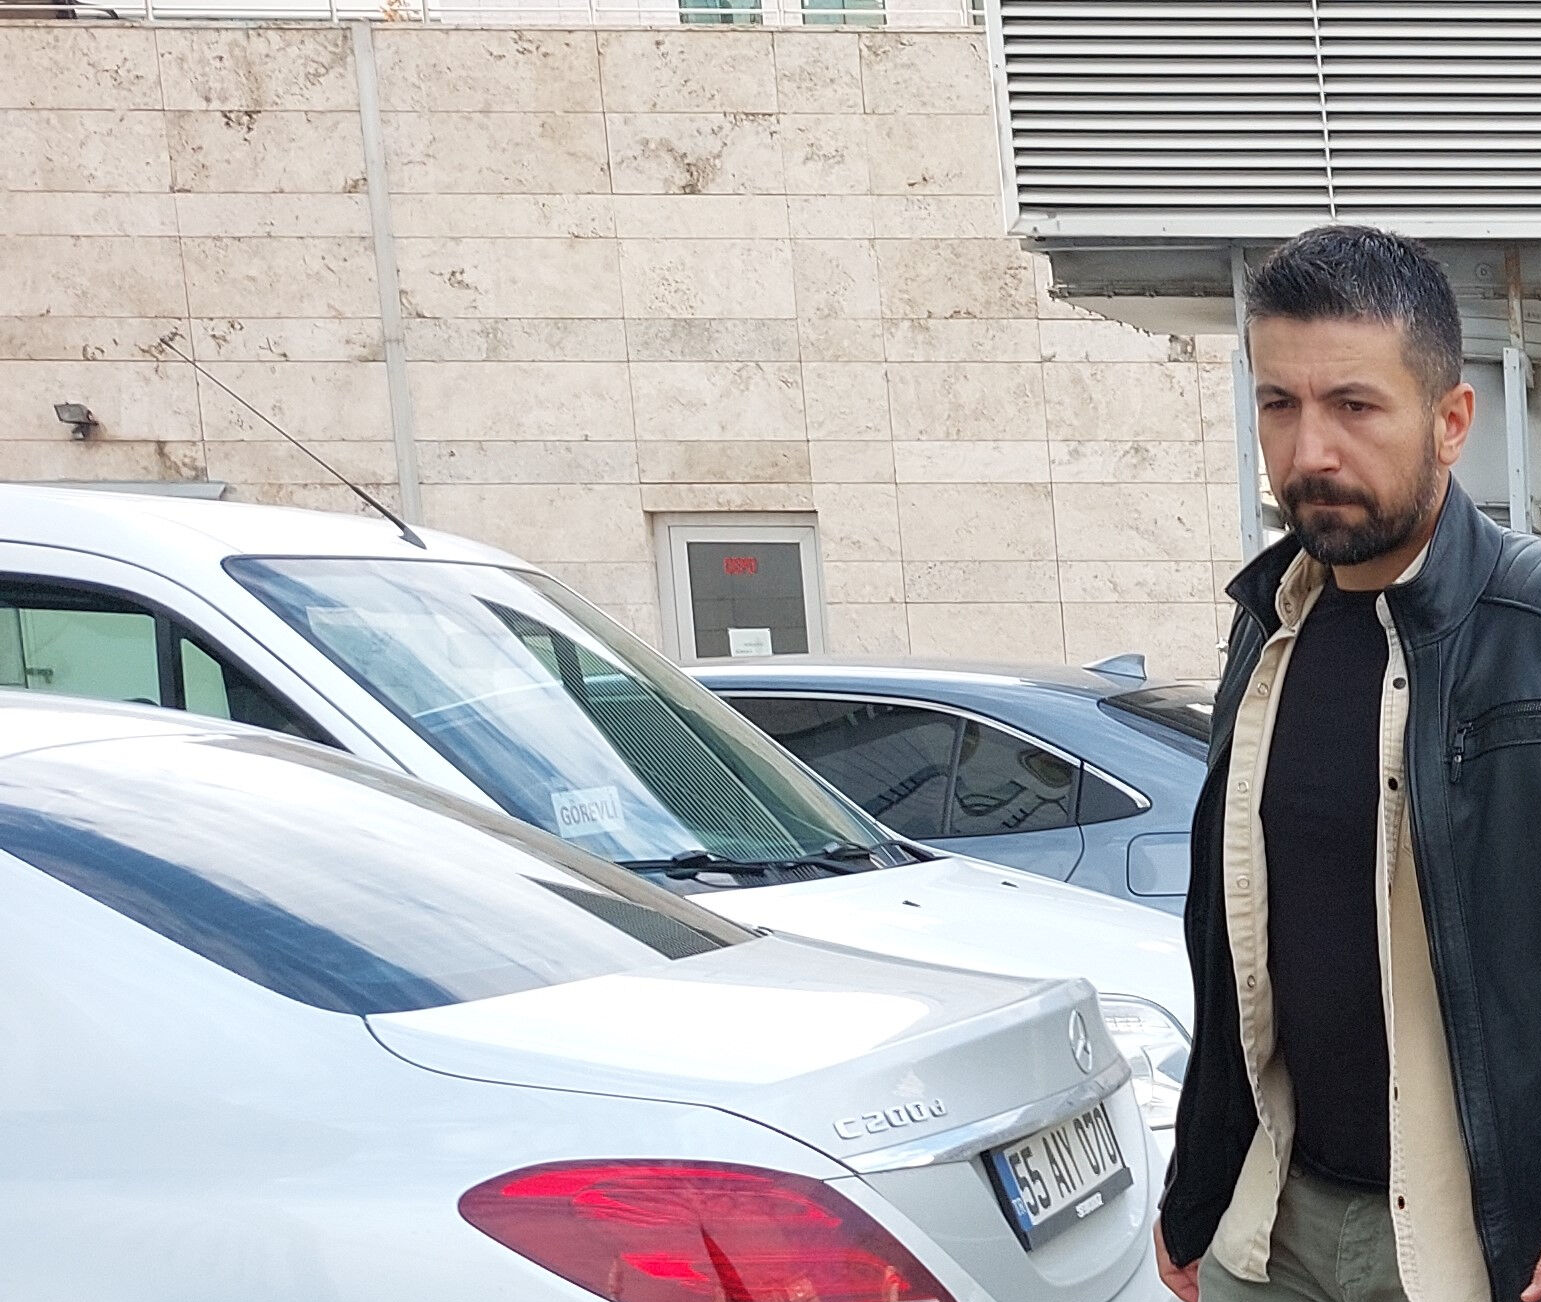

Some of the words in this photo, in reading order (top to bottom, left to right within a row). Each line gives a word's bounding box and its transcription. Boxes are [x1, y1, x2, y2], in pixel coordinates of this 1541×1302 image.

[559, 792, 620, 826] GÖREVLİ
[1008, 1146, 1051, 1216] 55
[1073, 1107, 1117, 1176] 070
